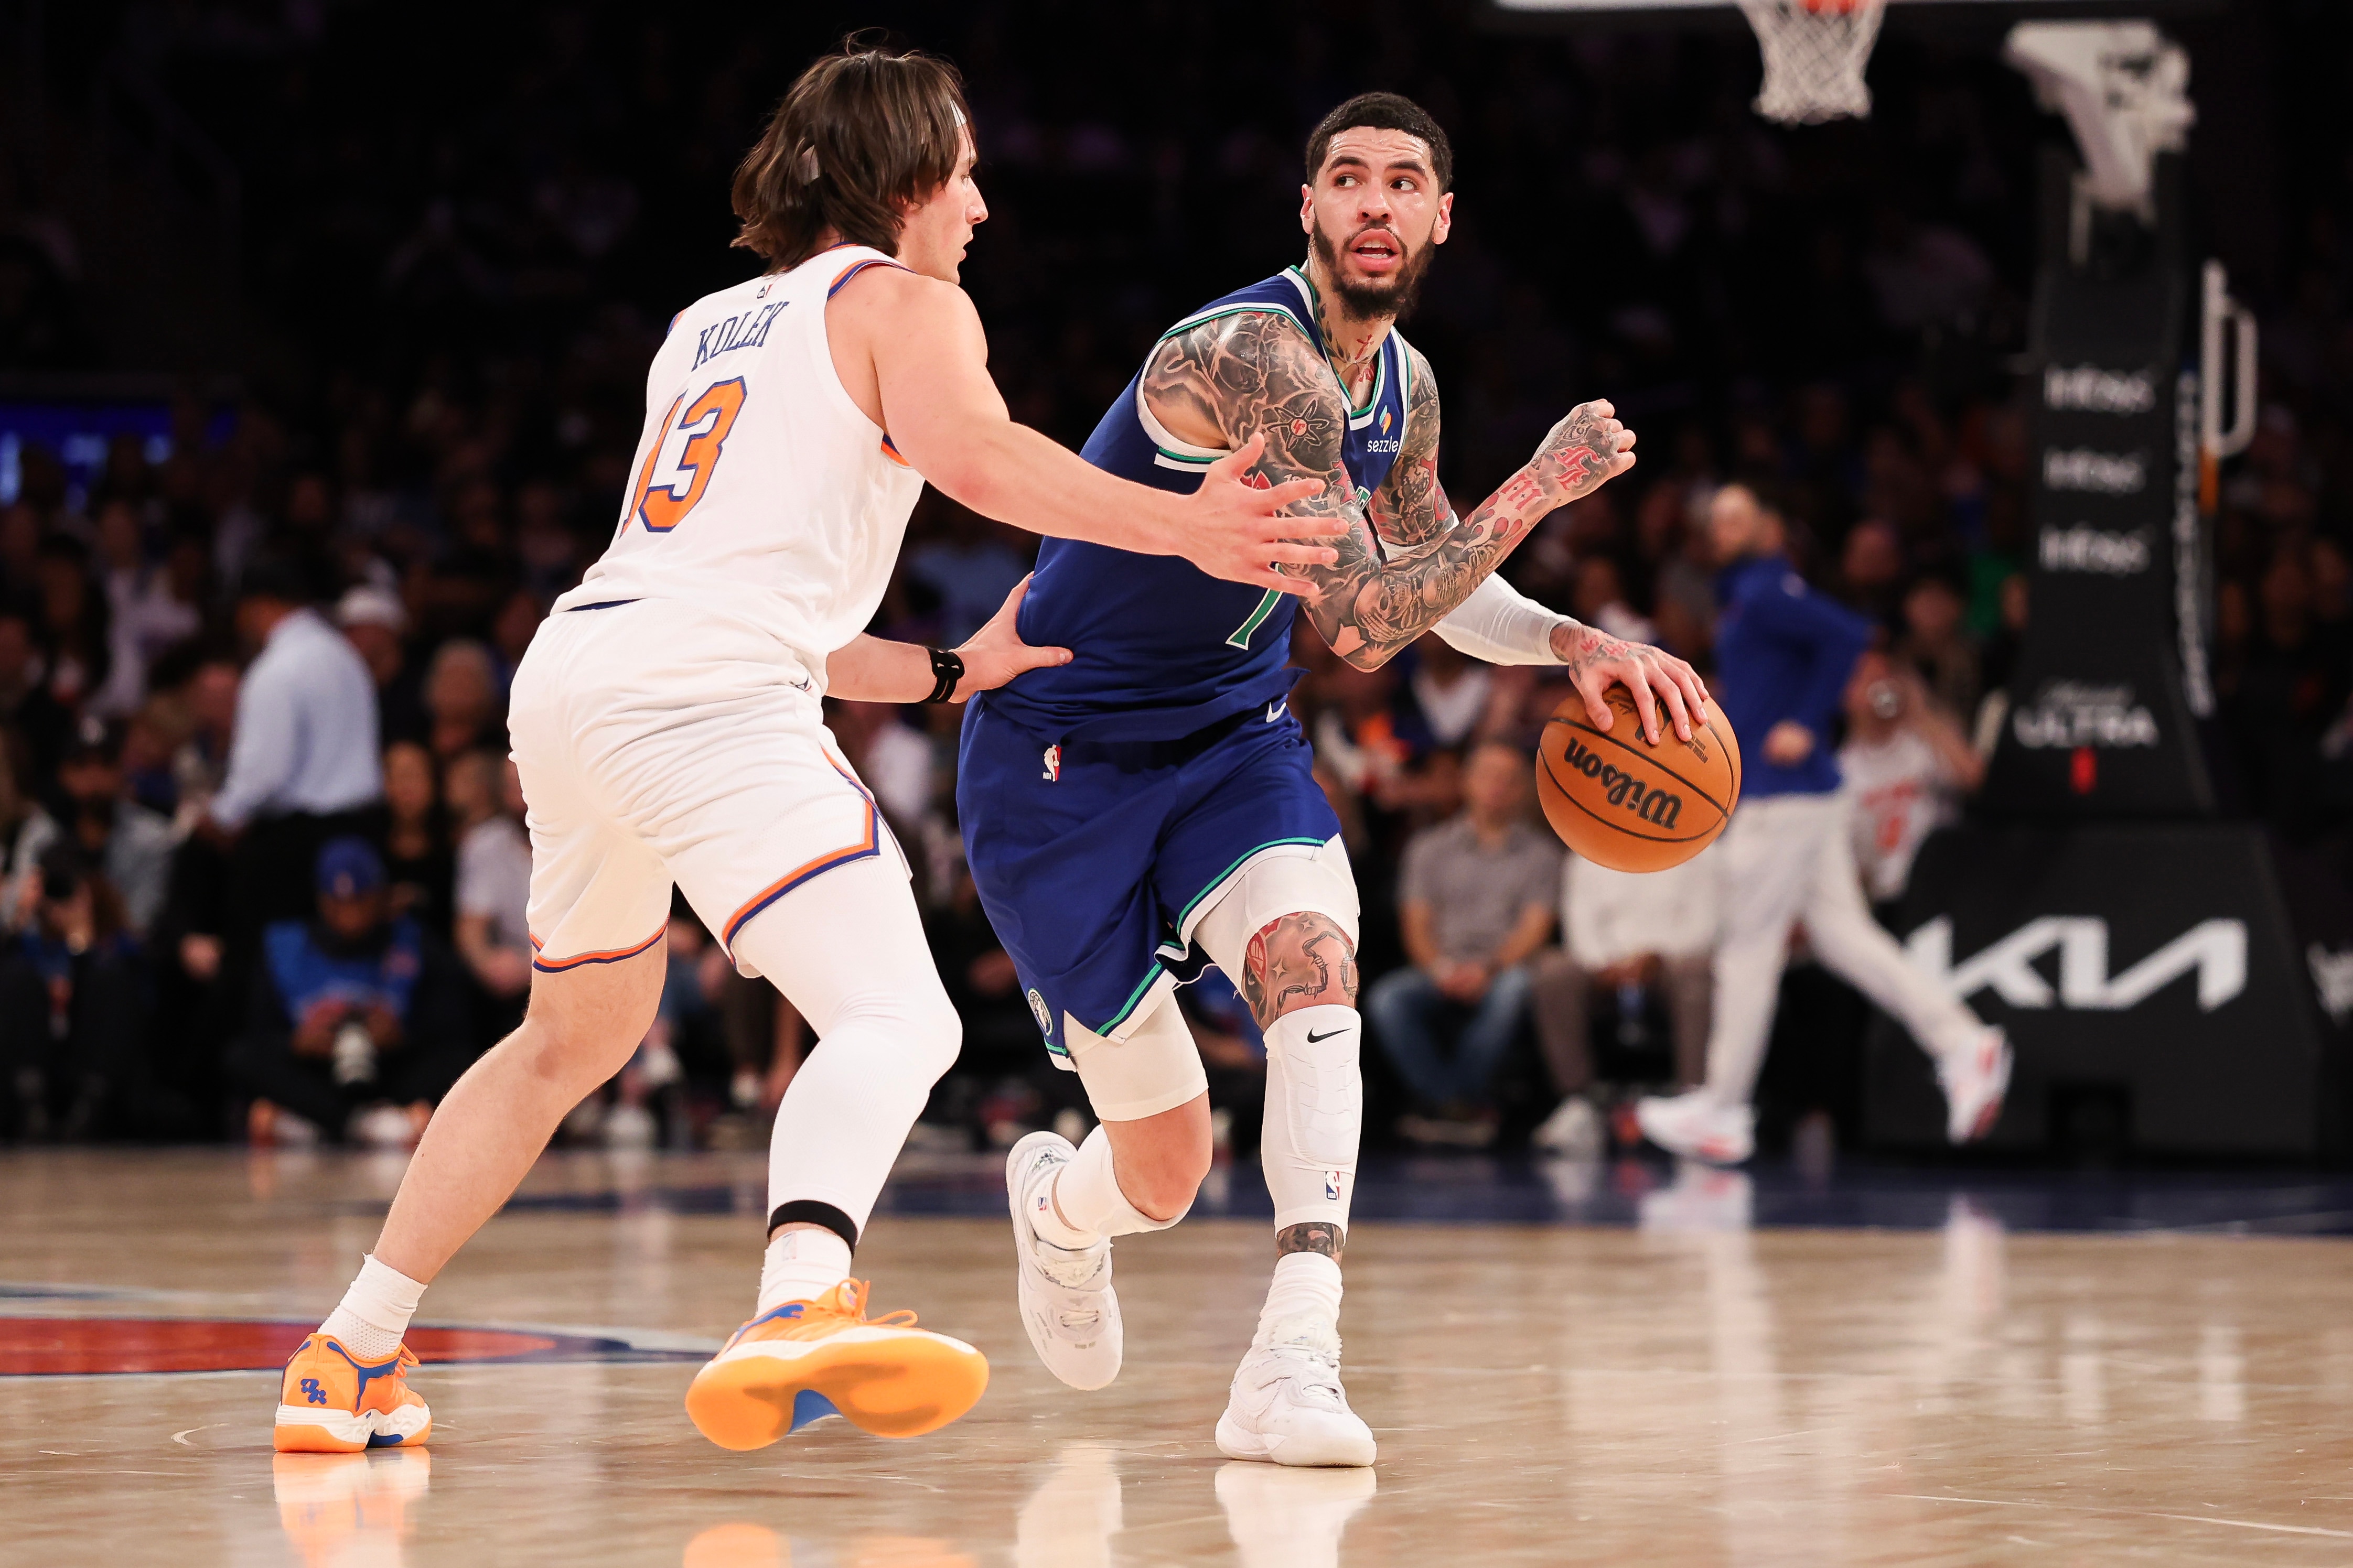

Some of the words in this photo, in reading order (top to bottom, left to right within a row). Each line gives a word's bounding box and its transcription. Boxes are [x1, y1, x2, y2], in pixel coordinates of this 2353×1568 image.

[691, 301, 790, 372] KOLEK
[619, 375, 748, 539] 13
[1367, 435, 1399, 453] sezzle
[1043, 772, 1052, 780] NBA
[1564, 737, 1683, 830] Wilson
